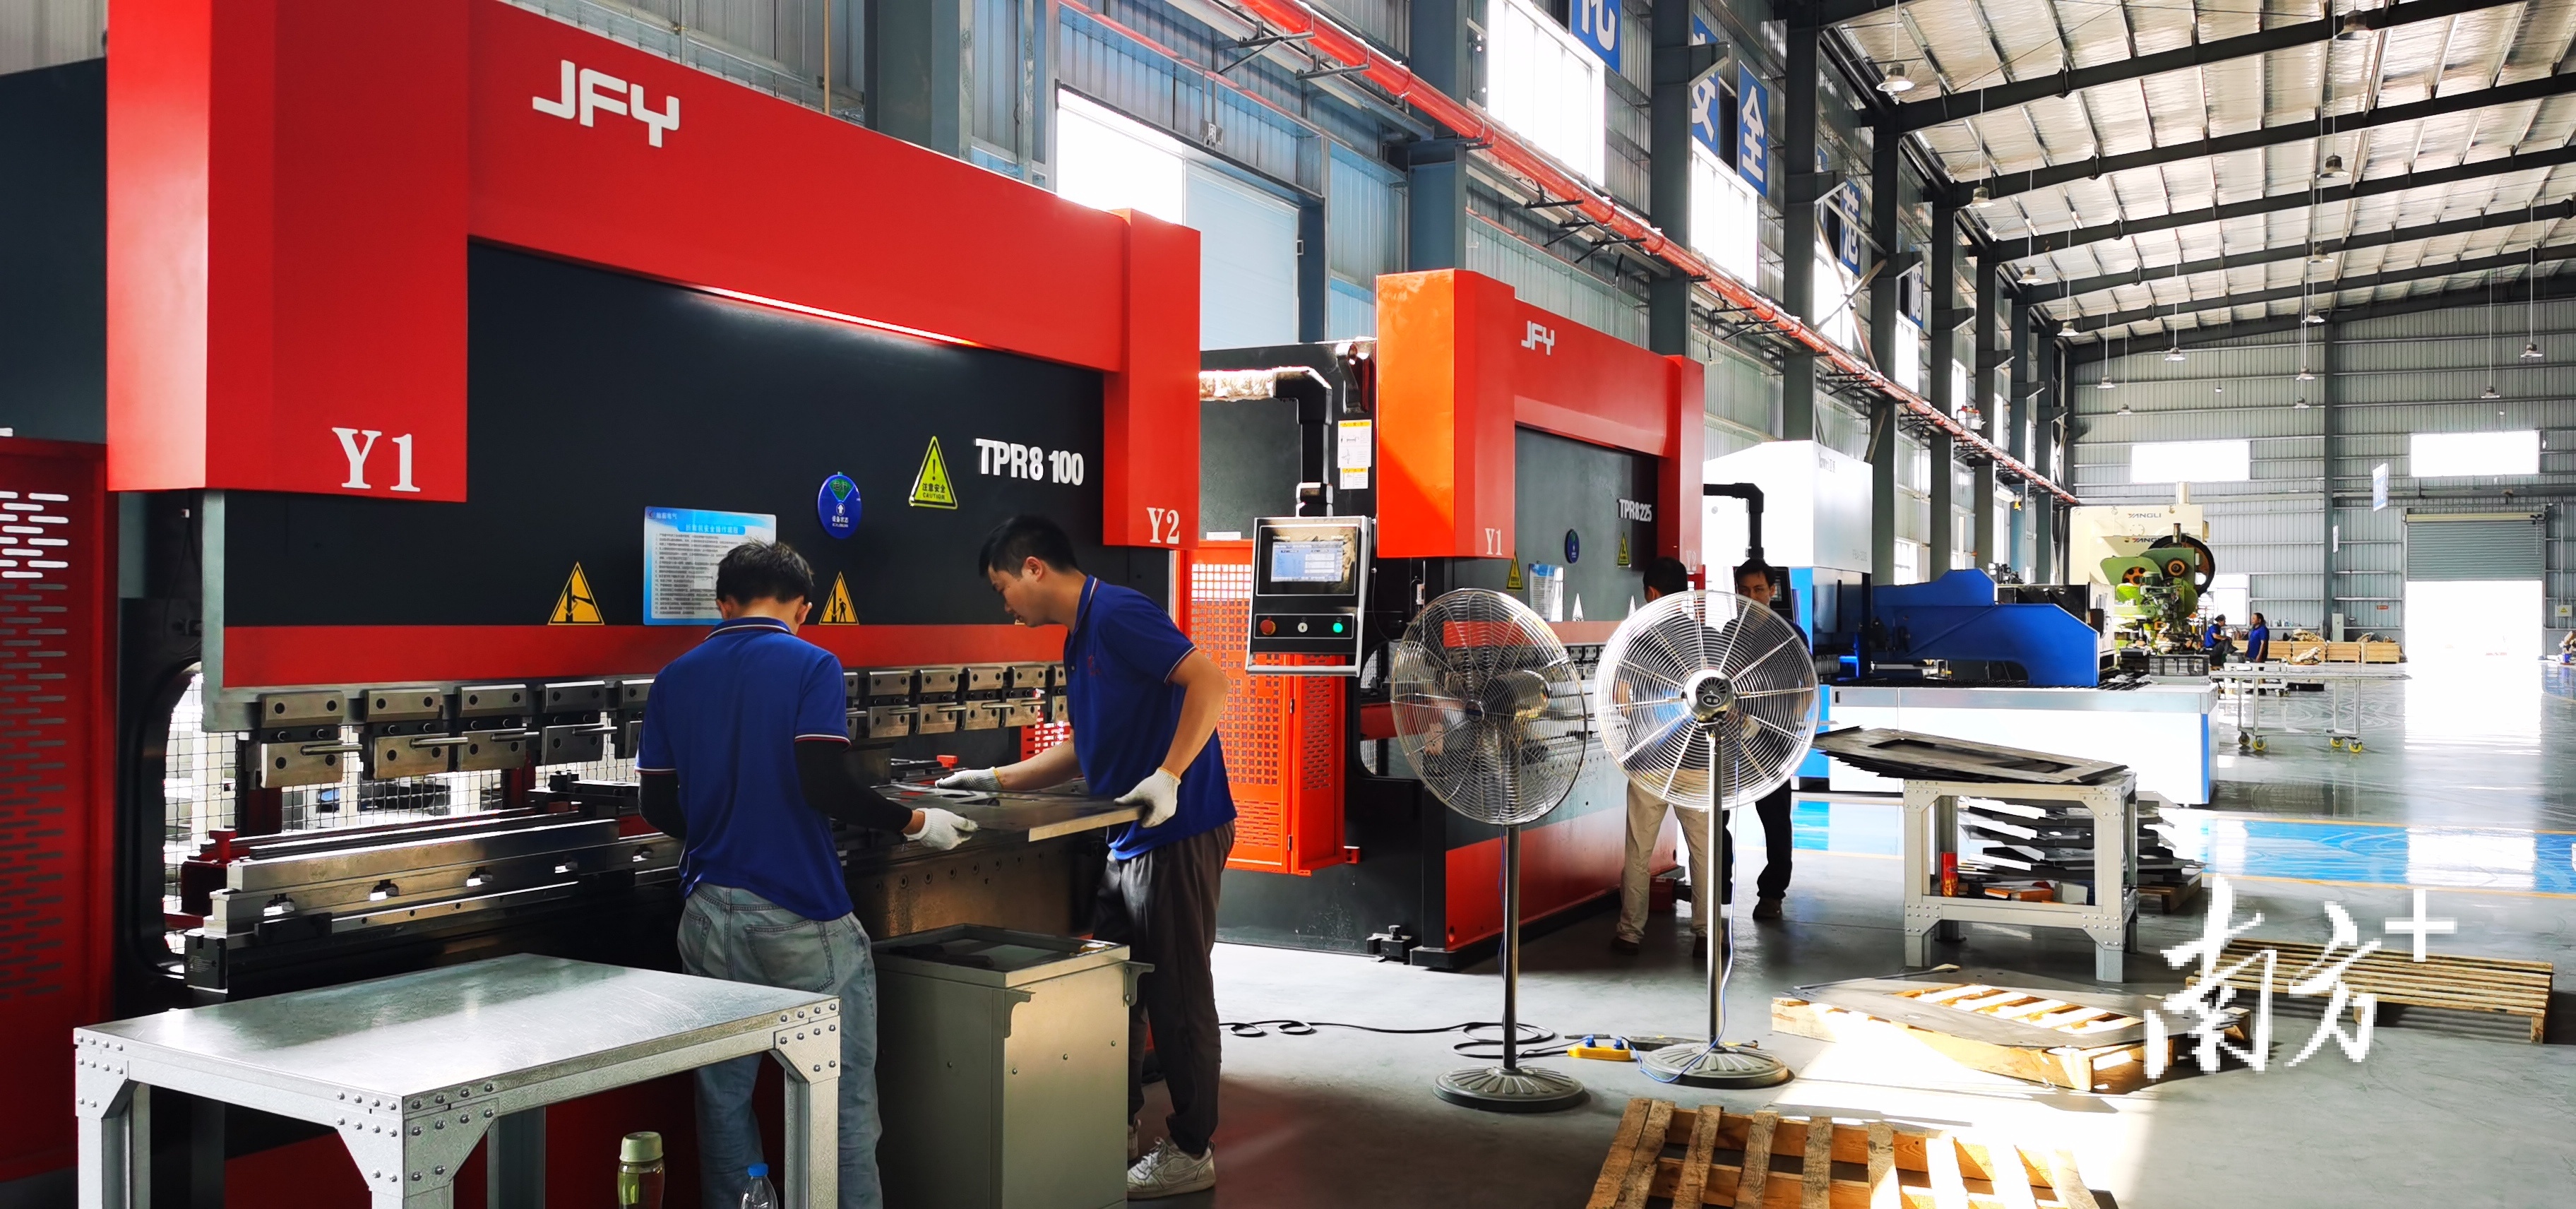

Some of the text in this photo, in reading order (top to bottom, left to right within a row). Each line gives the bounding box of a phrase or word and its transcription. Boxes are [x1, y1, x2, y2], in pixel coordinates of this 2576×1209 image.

[532, 59, 679, 148] JFY
[1521, 320, 1555, 355] JFY
[331, 427, 421, 492] Y1
[975, 438, 1084, 486] TPR8 100
[922, 482, 946, 493] 注意安全
[1146, 507, 1179, 544] Y2
[1484, 528, 1503, 556] Y1
